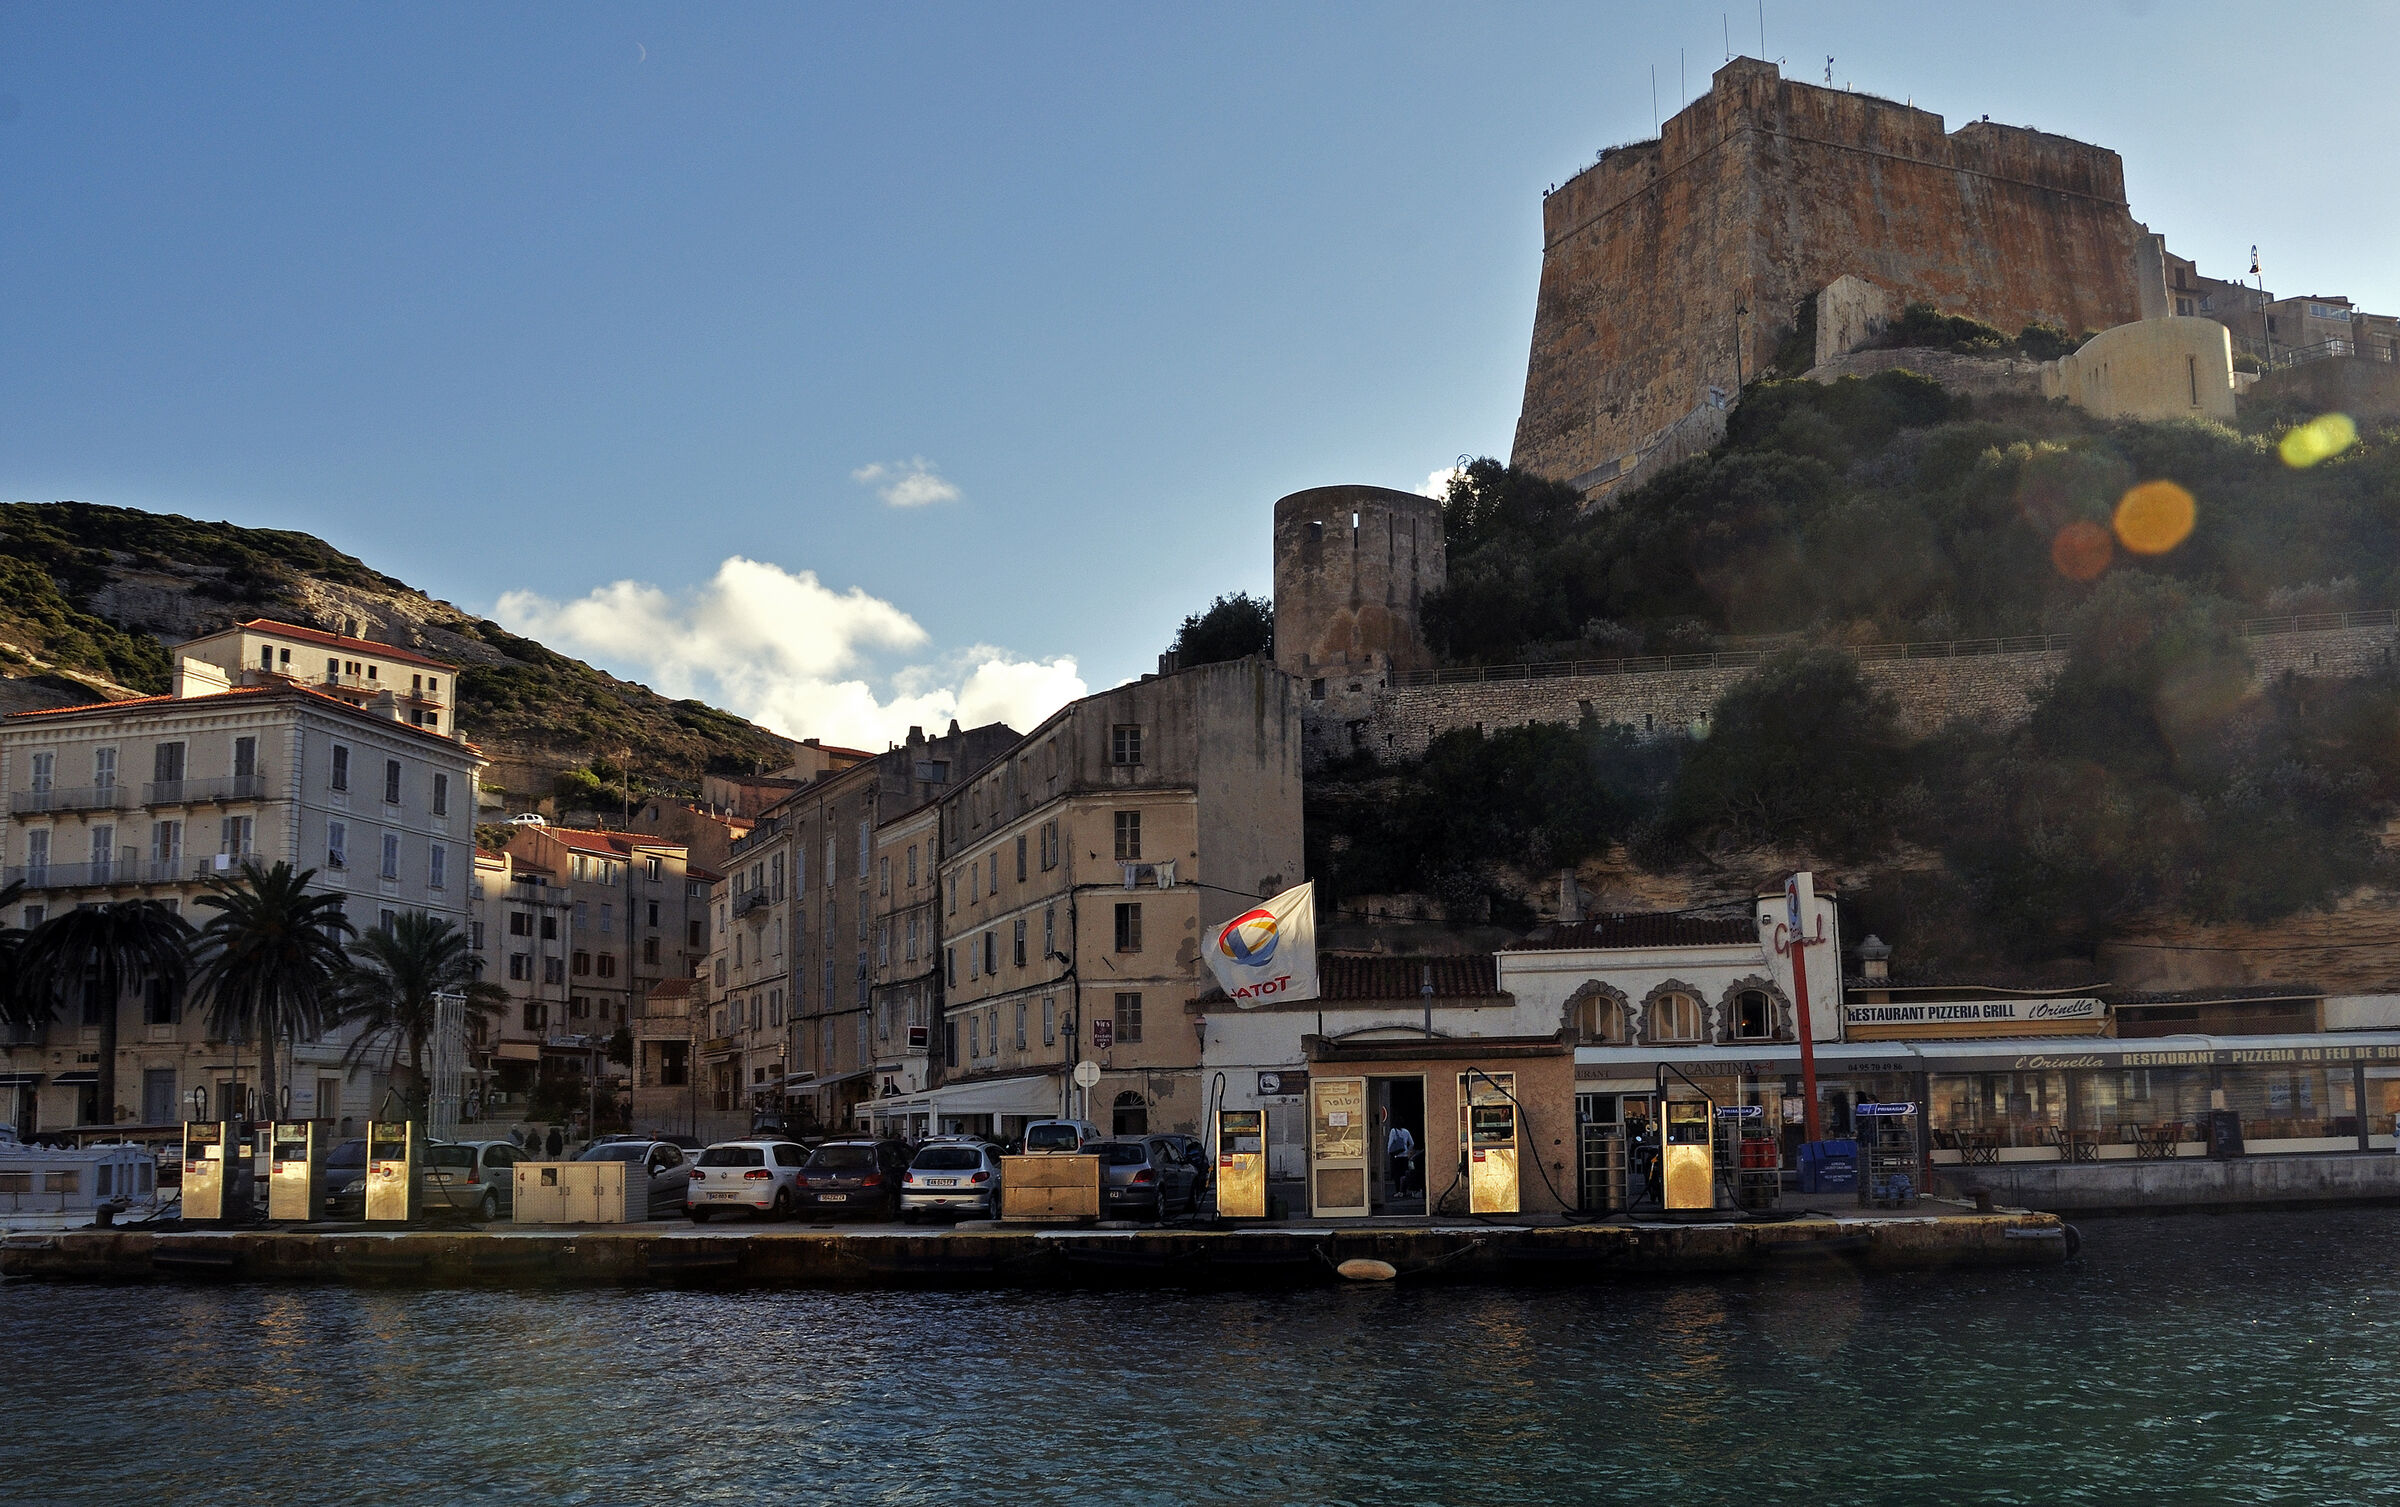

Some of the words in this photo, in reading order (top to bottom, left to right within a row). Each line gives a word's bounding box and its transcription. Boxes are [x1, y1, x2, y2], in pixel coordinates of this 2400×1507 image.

[1847, 1006, 1924, 1022] RESTAURANT
[1928, 1004, 1980, 1020] PIZZERIA
[1983, 1003, 2016, 1018] GRILL
[2122, 1050, 2216, 1066] RESTAURANT
[2232, 1047, 2297, 1063] PIZZERIA
[2301, 1047, 2321, 1061] AU
[2325, 1046, 2350, 1060] FEU
[2355, 1045, 2373, 1059] DE
[1684, 1062, 1754, 1076] CANTINA
